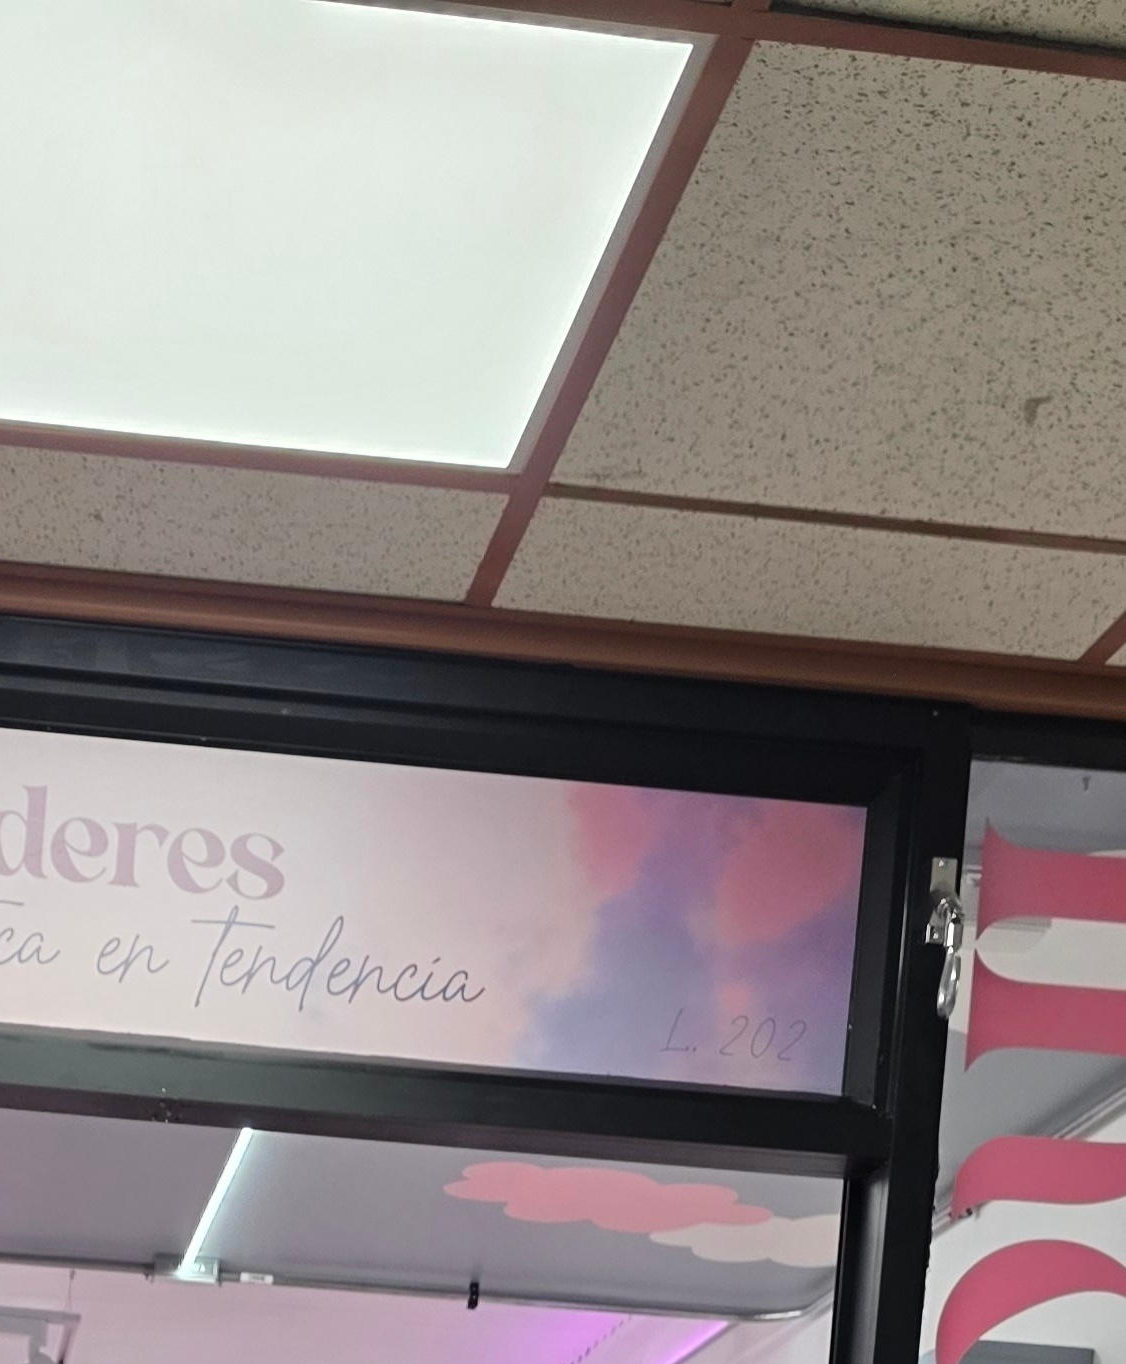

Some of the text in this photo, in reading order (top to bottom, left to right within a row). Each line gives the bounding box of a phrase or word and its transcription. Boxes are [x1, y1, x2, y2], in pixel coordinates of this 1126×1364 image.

[96, 934, 170, 983] en
[191, 905, 486, 1011] tendencia
[659, 1008, 807, 1061] L. 202
